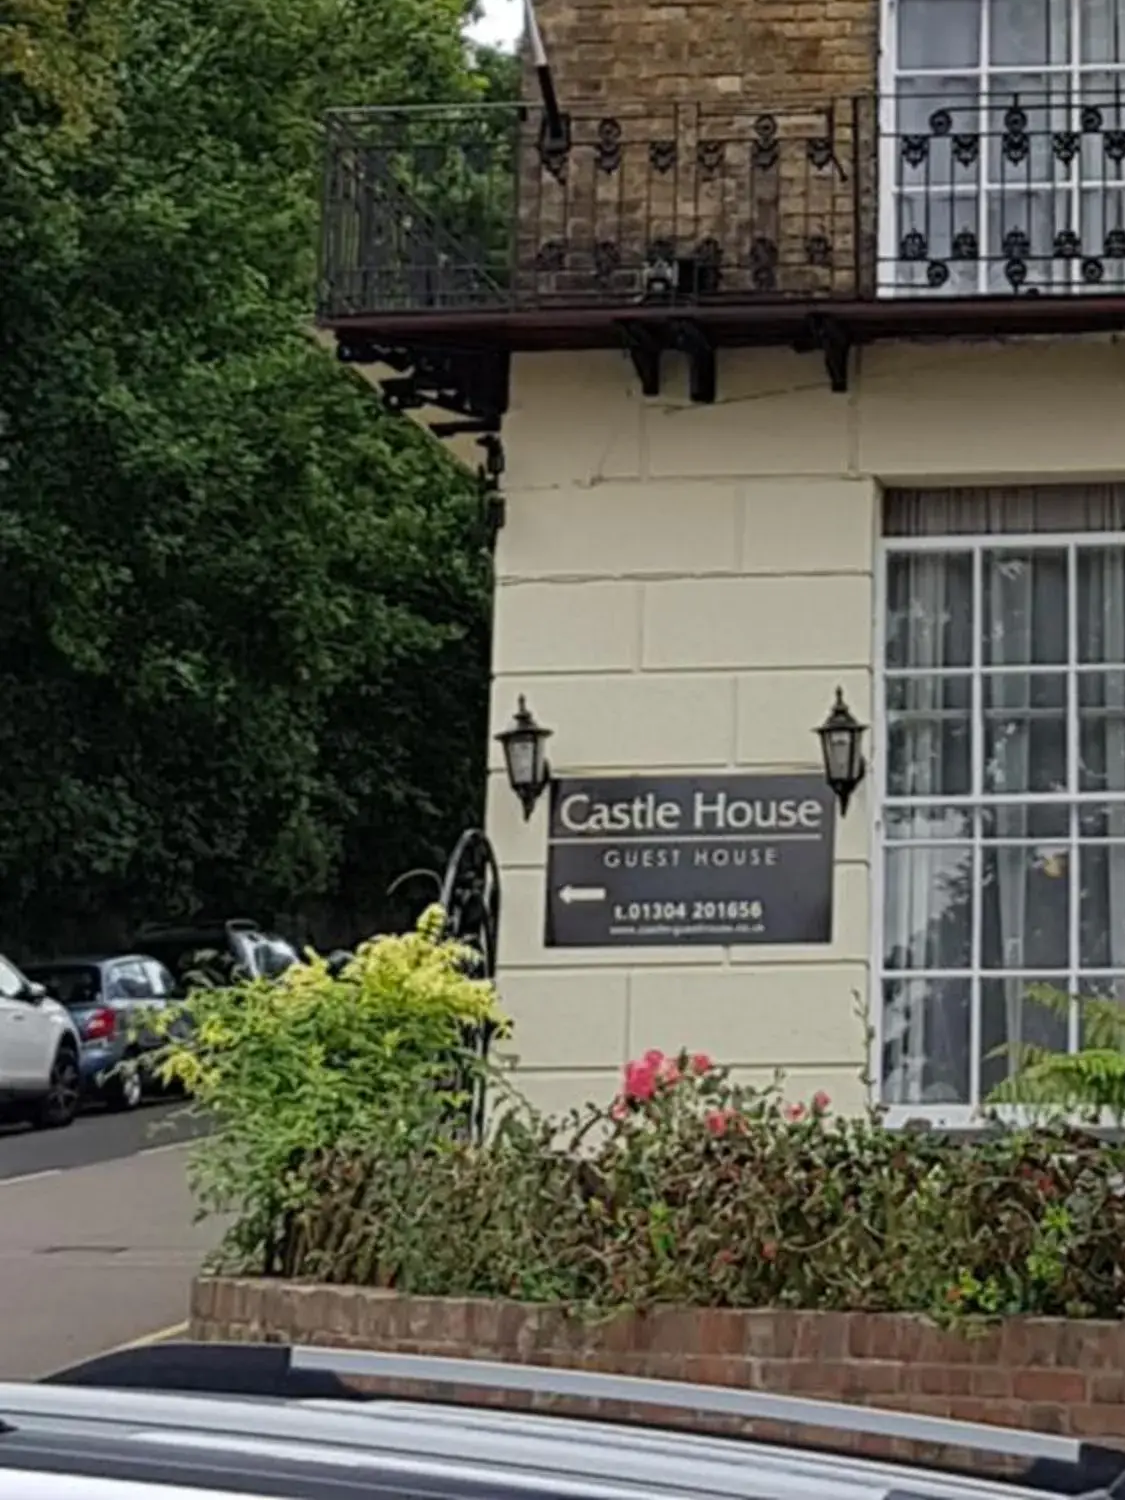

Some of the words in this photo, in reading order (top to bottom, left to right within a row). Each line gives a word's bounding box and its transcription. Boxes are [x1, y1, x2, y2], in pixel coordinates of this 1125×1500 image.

[560, 793, 681, 831] Castle
[694, 792, 823, 829] House
[603, 849, 680, 868] GUEST
[694, 847, 778, 866] HOUSE
[692, 900, 763, 919] 201656
